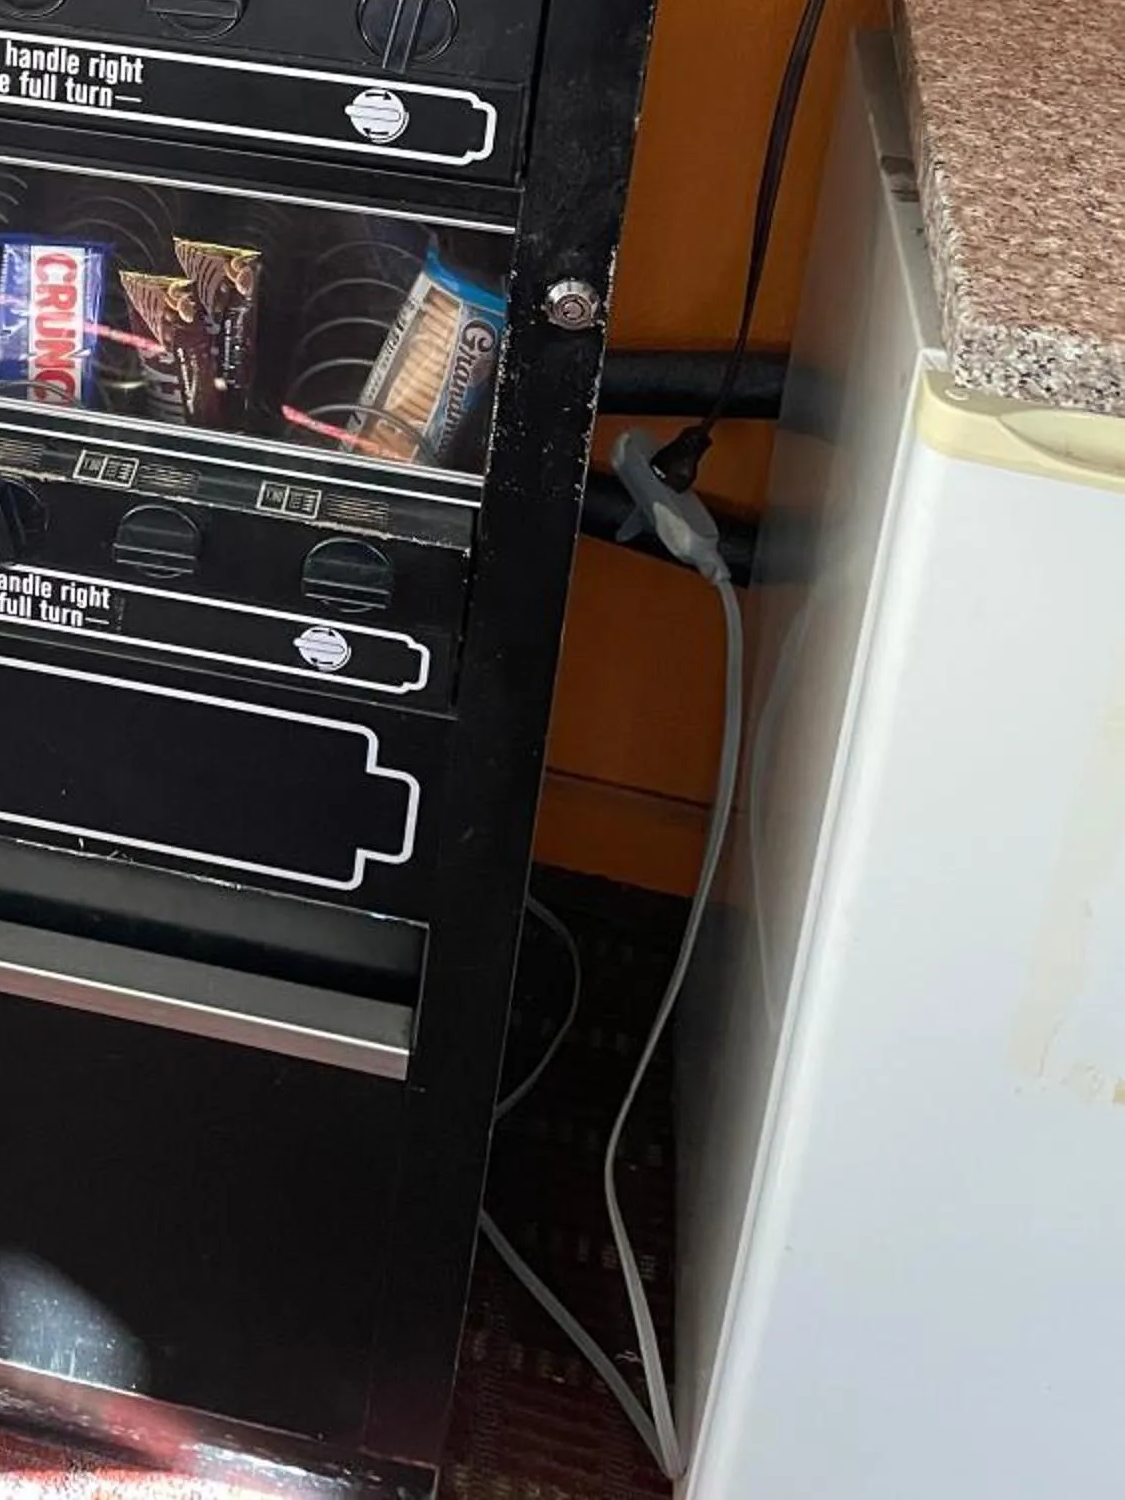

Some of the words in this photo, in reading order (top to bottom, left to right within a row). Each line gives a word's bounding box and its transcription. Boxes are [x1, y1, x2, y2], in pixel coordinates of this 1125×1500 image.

[5, 39, 80, 75] handle
[88, 53, 144, 85] right
[18, 70, 57, 100] full
[60, 582, 111, 609] right
